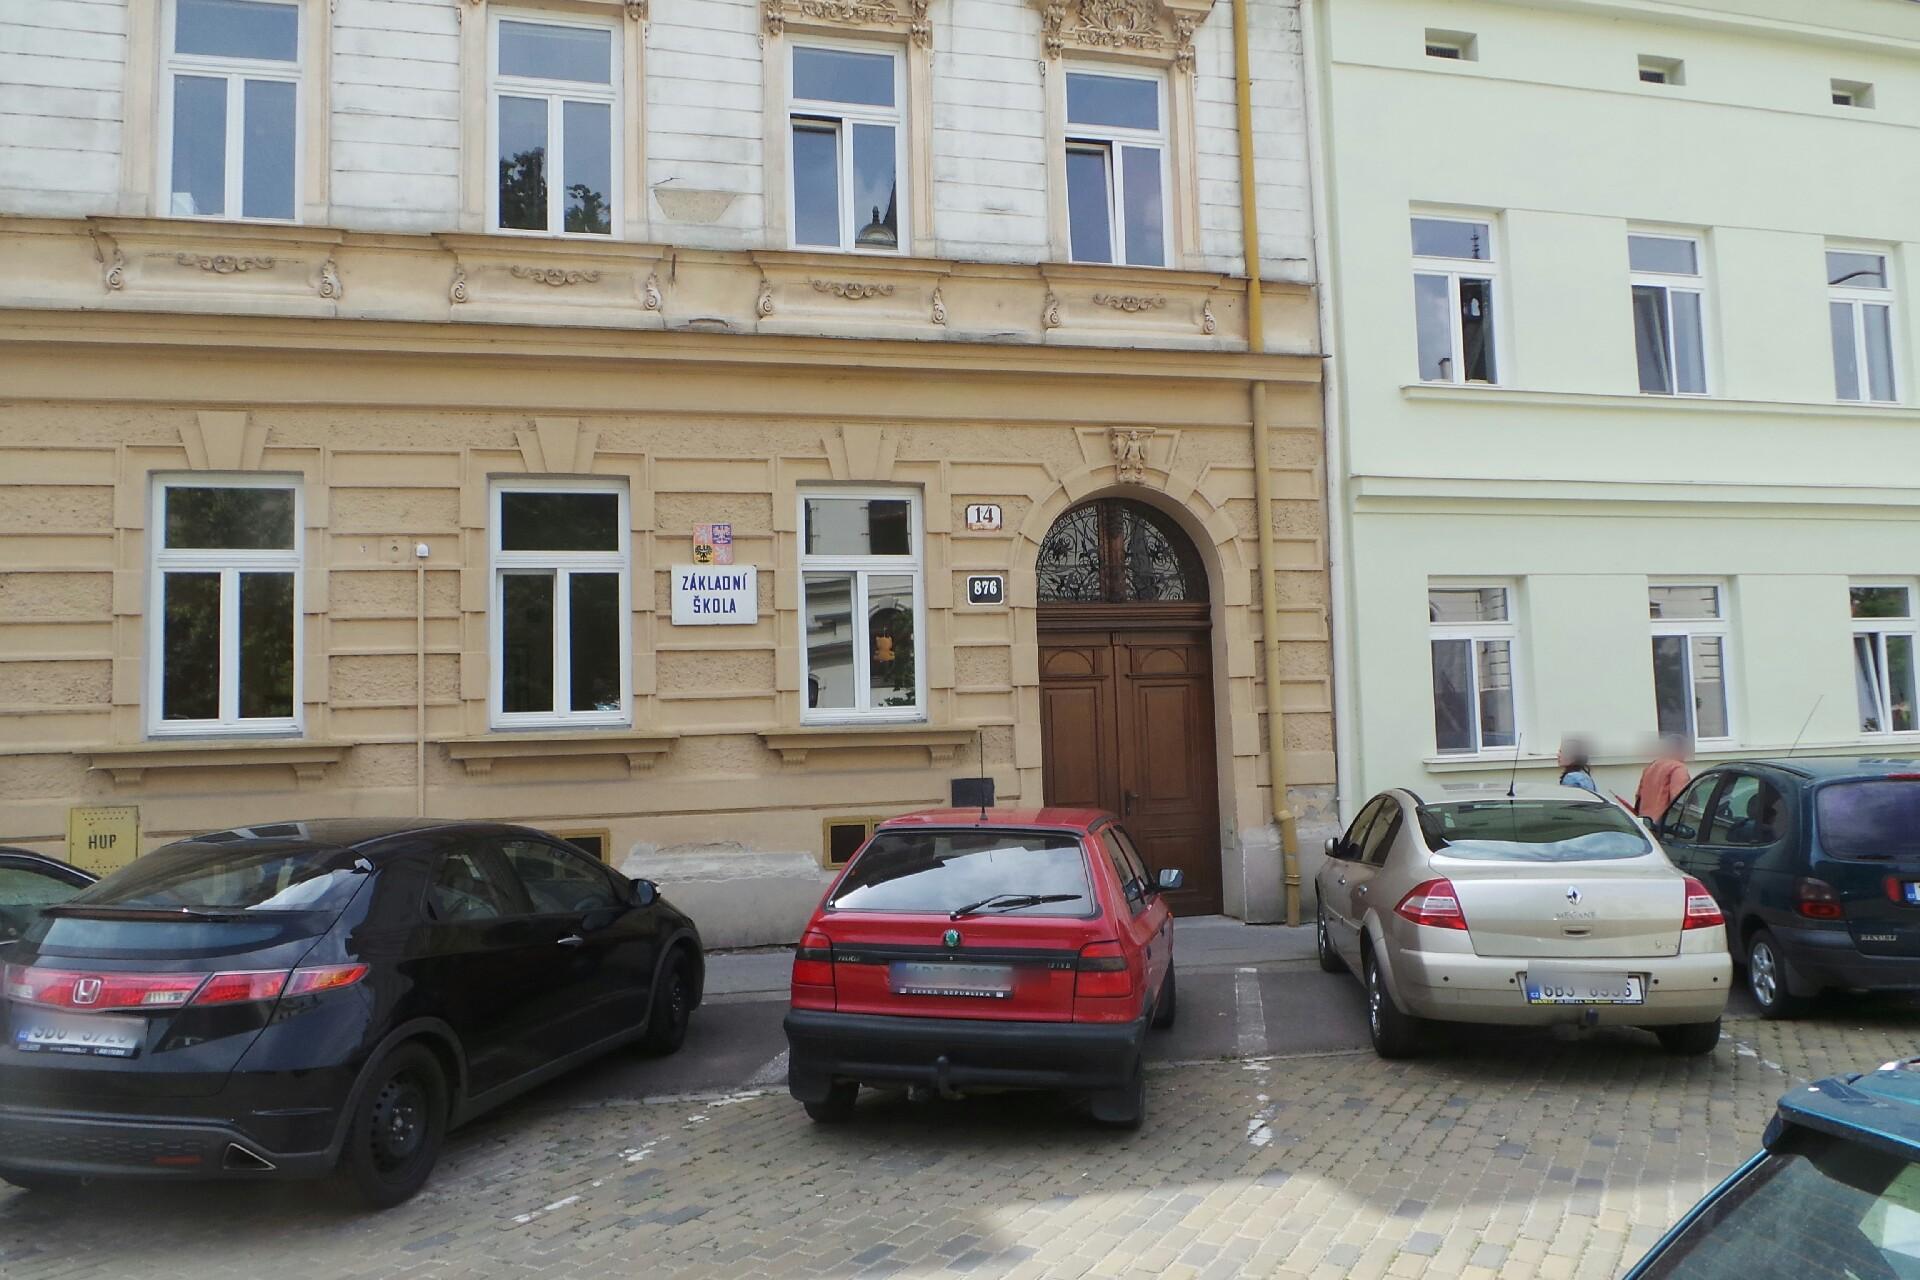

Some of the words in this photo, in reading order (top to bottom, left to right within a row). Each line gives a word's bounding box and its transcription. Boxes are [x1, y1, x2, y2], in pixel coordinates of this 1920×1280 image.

[976, 506, 994, 524] 14
[682, 572, 747, 591] ZÁKLADNÍ
[974, 580, 998, 596] 876
[693, 595, 737, 614] ŠKOLA
[88, 834, 117, 850] HUP
